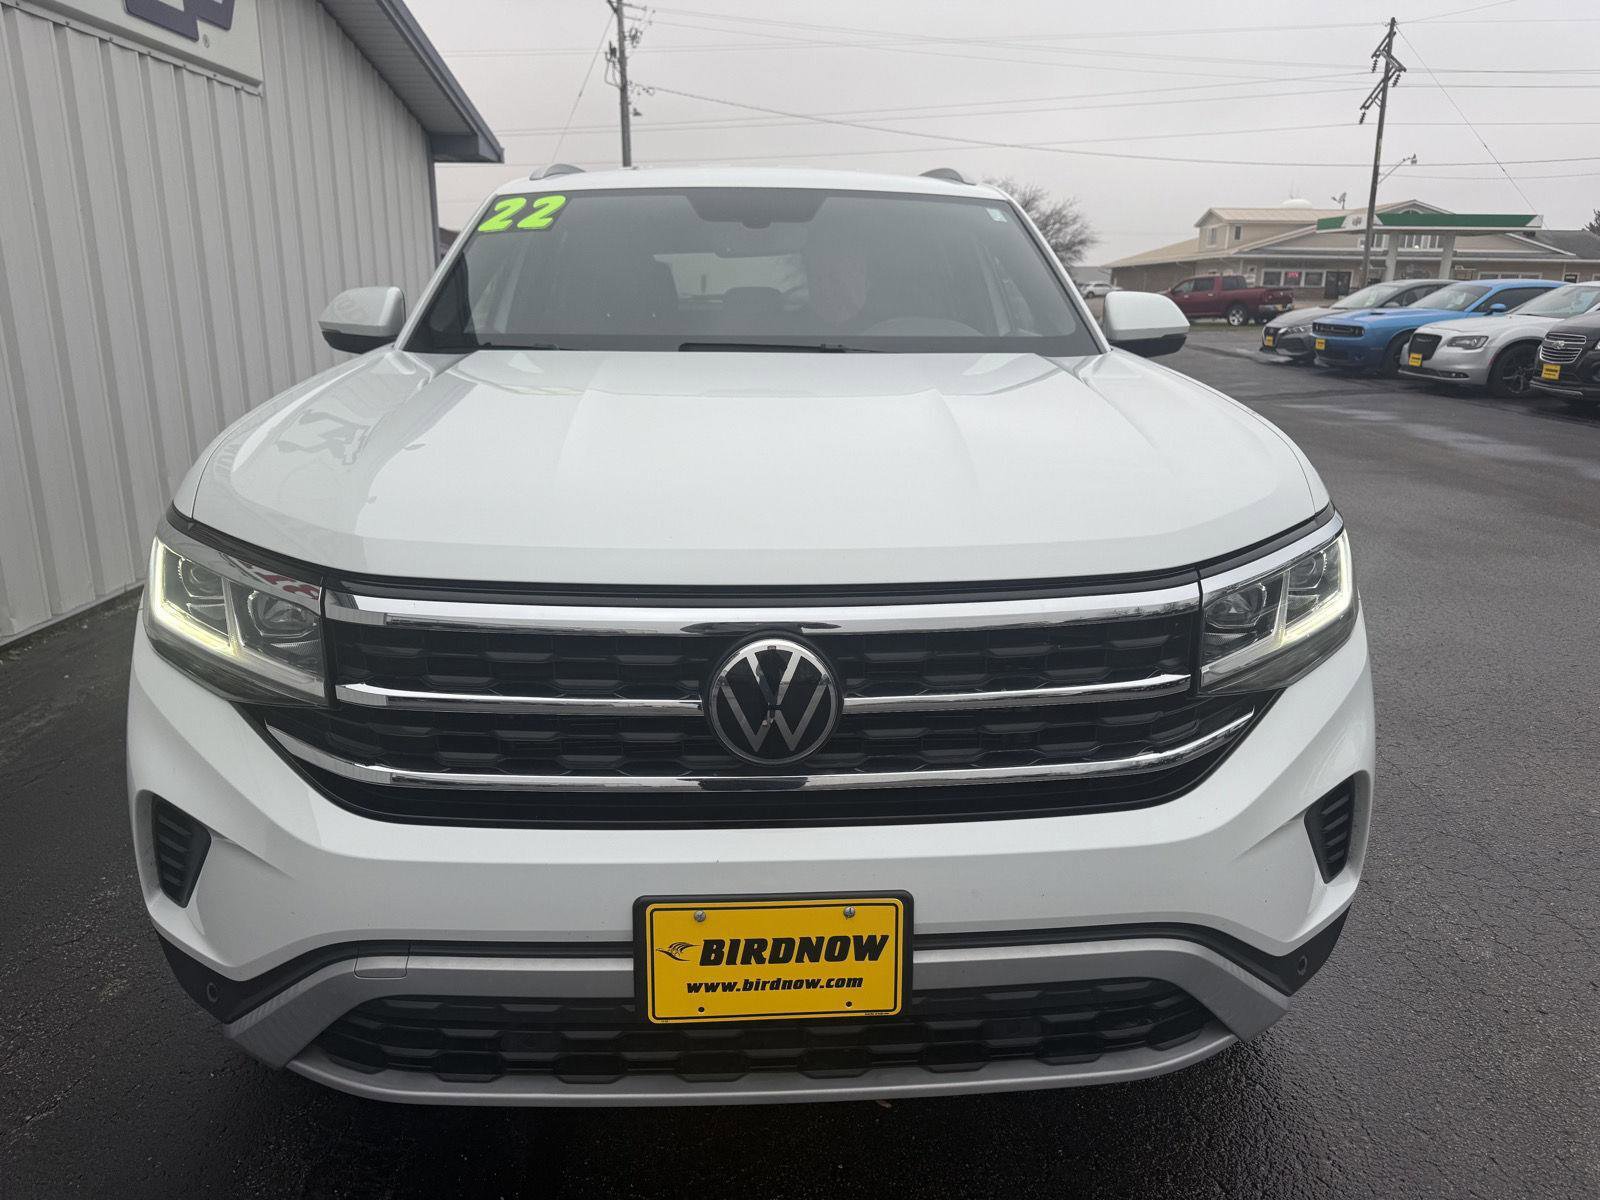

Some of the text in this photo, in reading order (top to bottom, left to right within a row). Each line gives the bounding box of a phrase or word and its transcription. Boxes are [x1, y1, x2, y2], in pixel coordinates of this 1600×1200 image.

[477, 195, 567, 232] 22
[699, 934, 890, 967] BIRDNOW
[686, 977, 864, 994] www.birdnow.com
